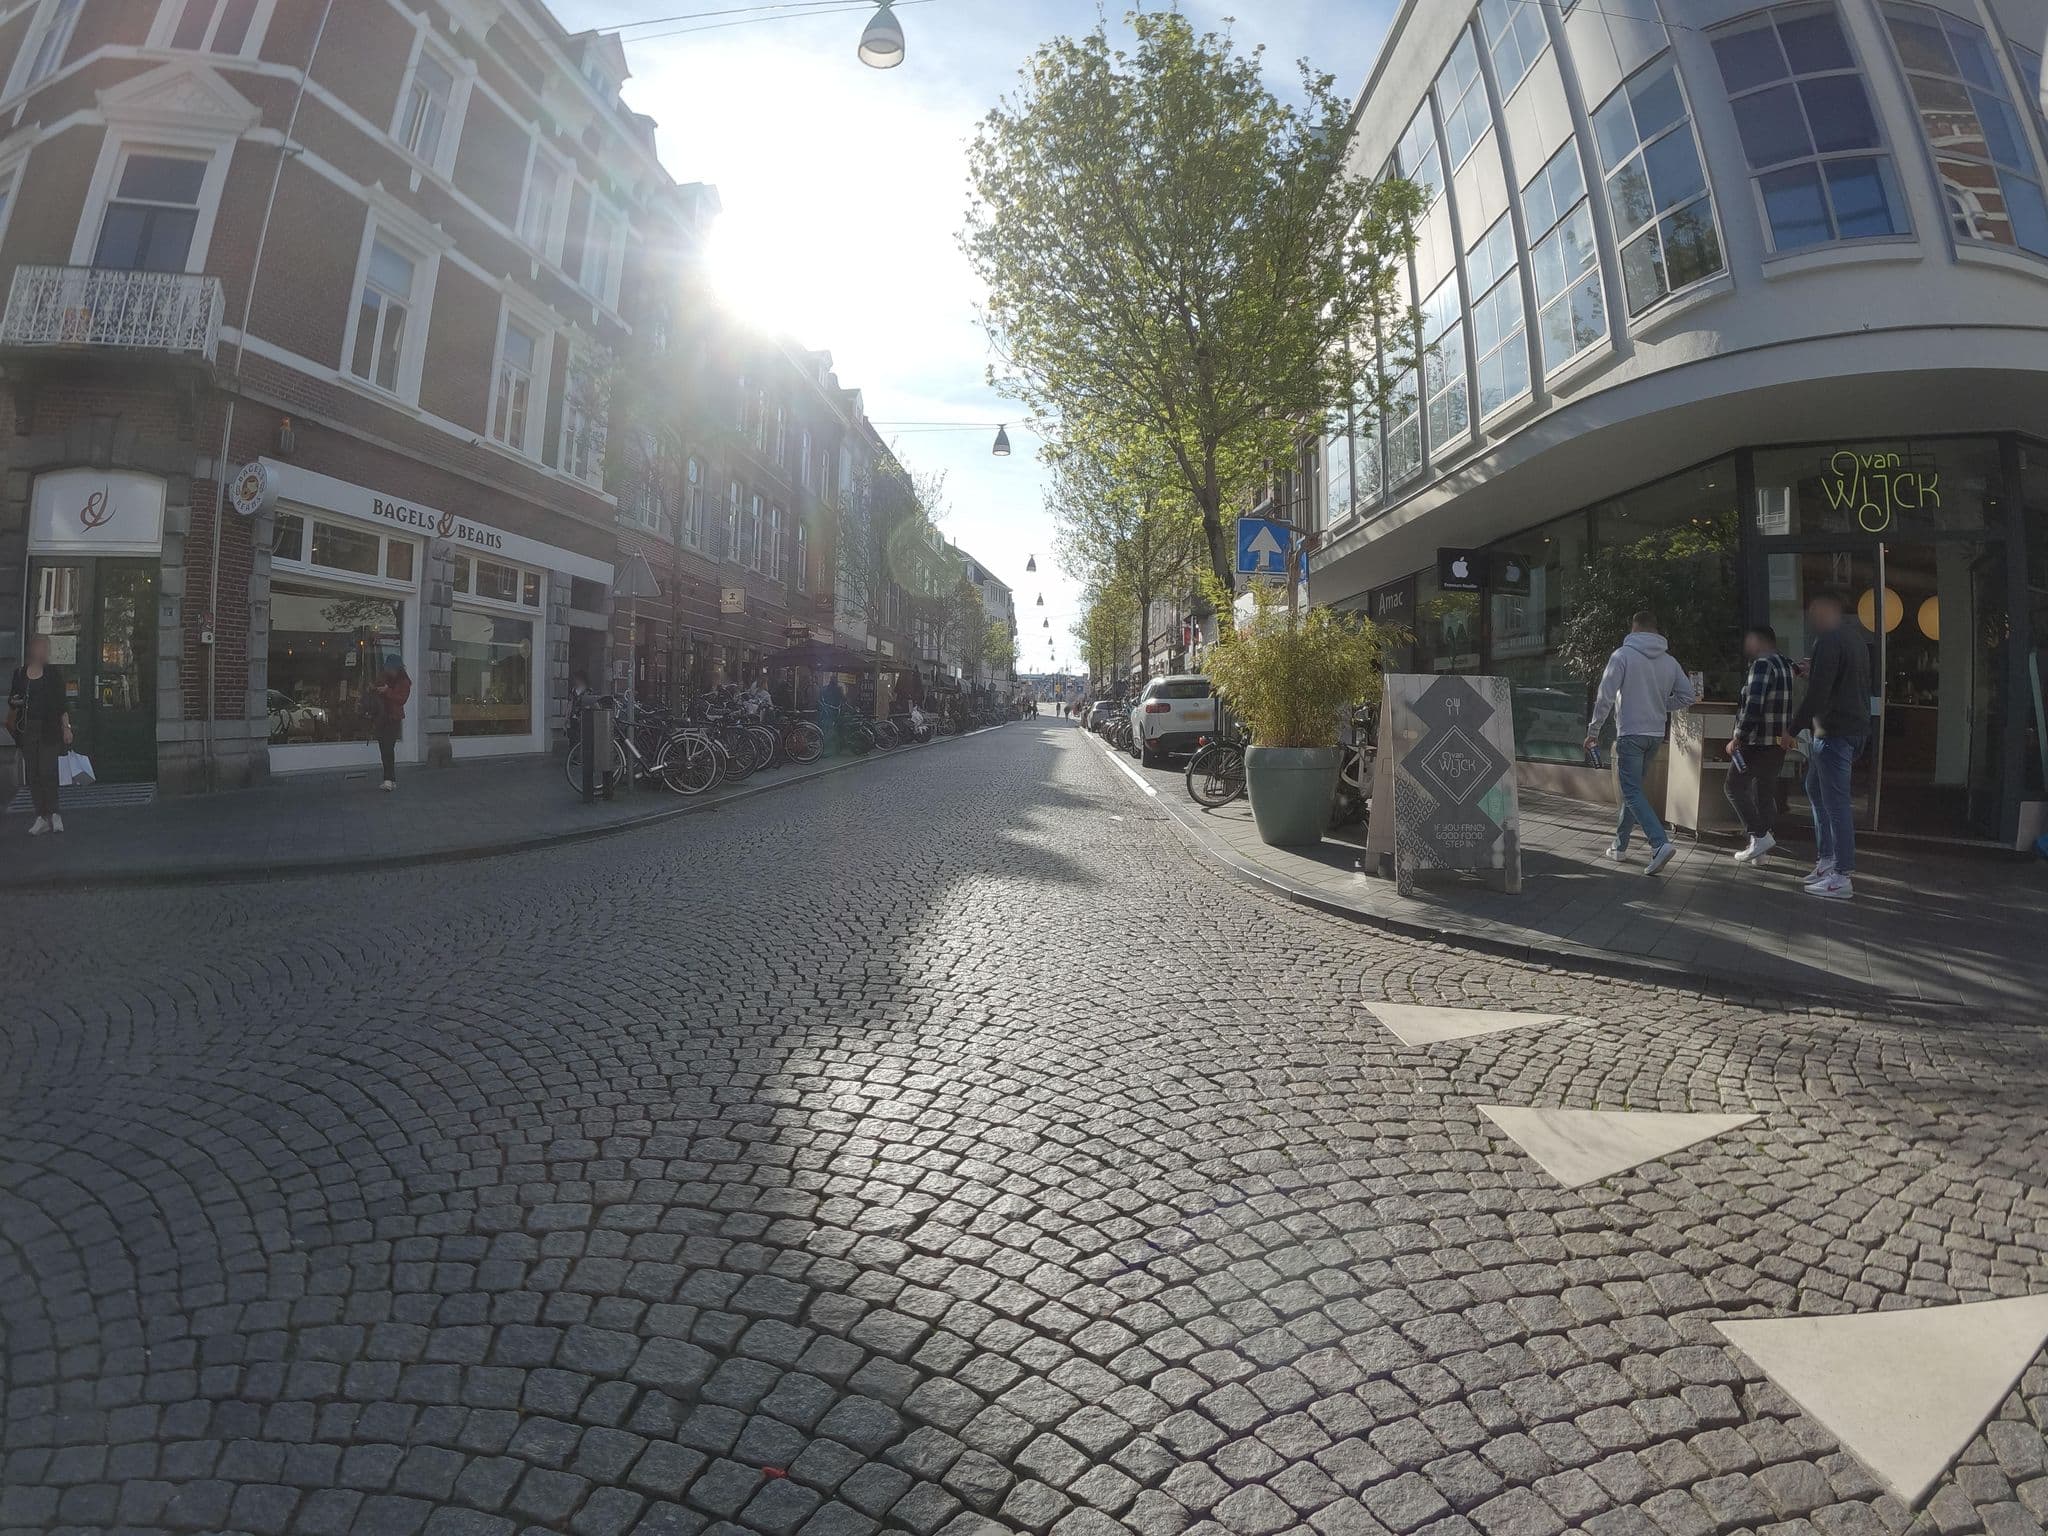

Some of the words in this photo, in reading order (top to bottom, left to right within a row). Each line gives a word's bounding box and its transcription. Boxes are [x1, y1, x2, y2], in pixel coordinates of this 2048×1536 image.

[1860, 452, 1901, 469] van
[371, 498, 436, 531] BAGELS
[437, 511, 458, 538] &
[457, 523, 503, 549] BEANS
[1378, 591, 1404, 616] Amac
[1451, 752, 1465, 760] van
[1434, 823, 1441, 832] IF
[1442, 823, 1460, 832] YOU
[1435, 831, 1460, 840] GOOD
[1445, 840, 1465, 848] STEP
